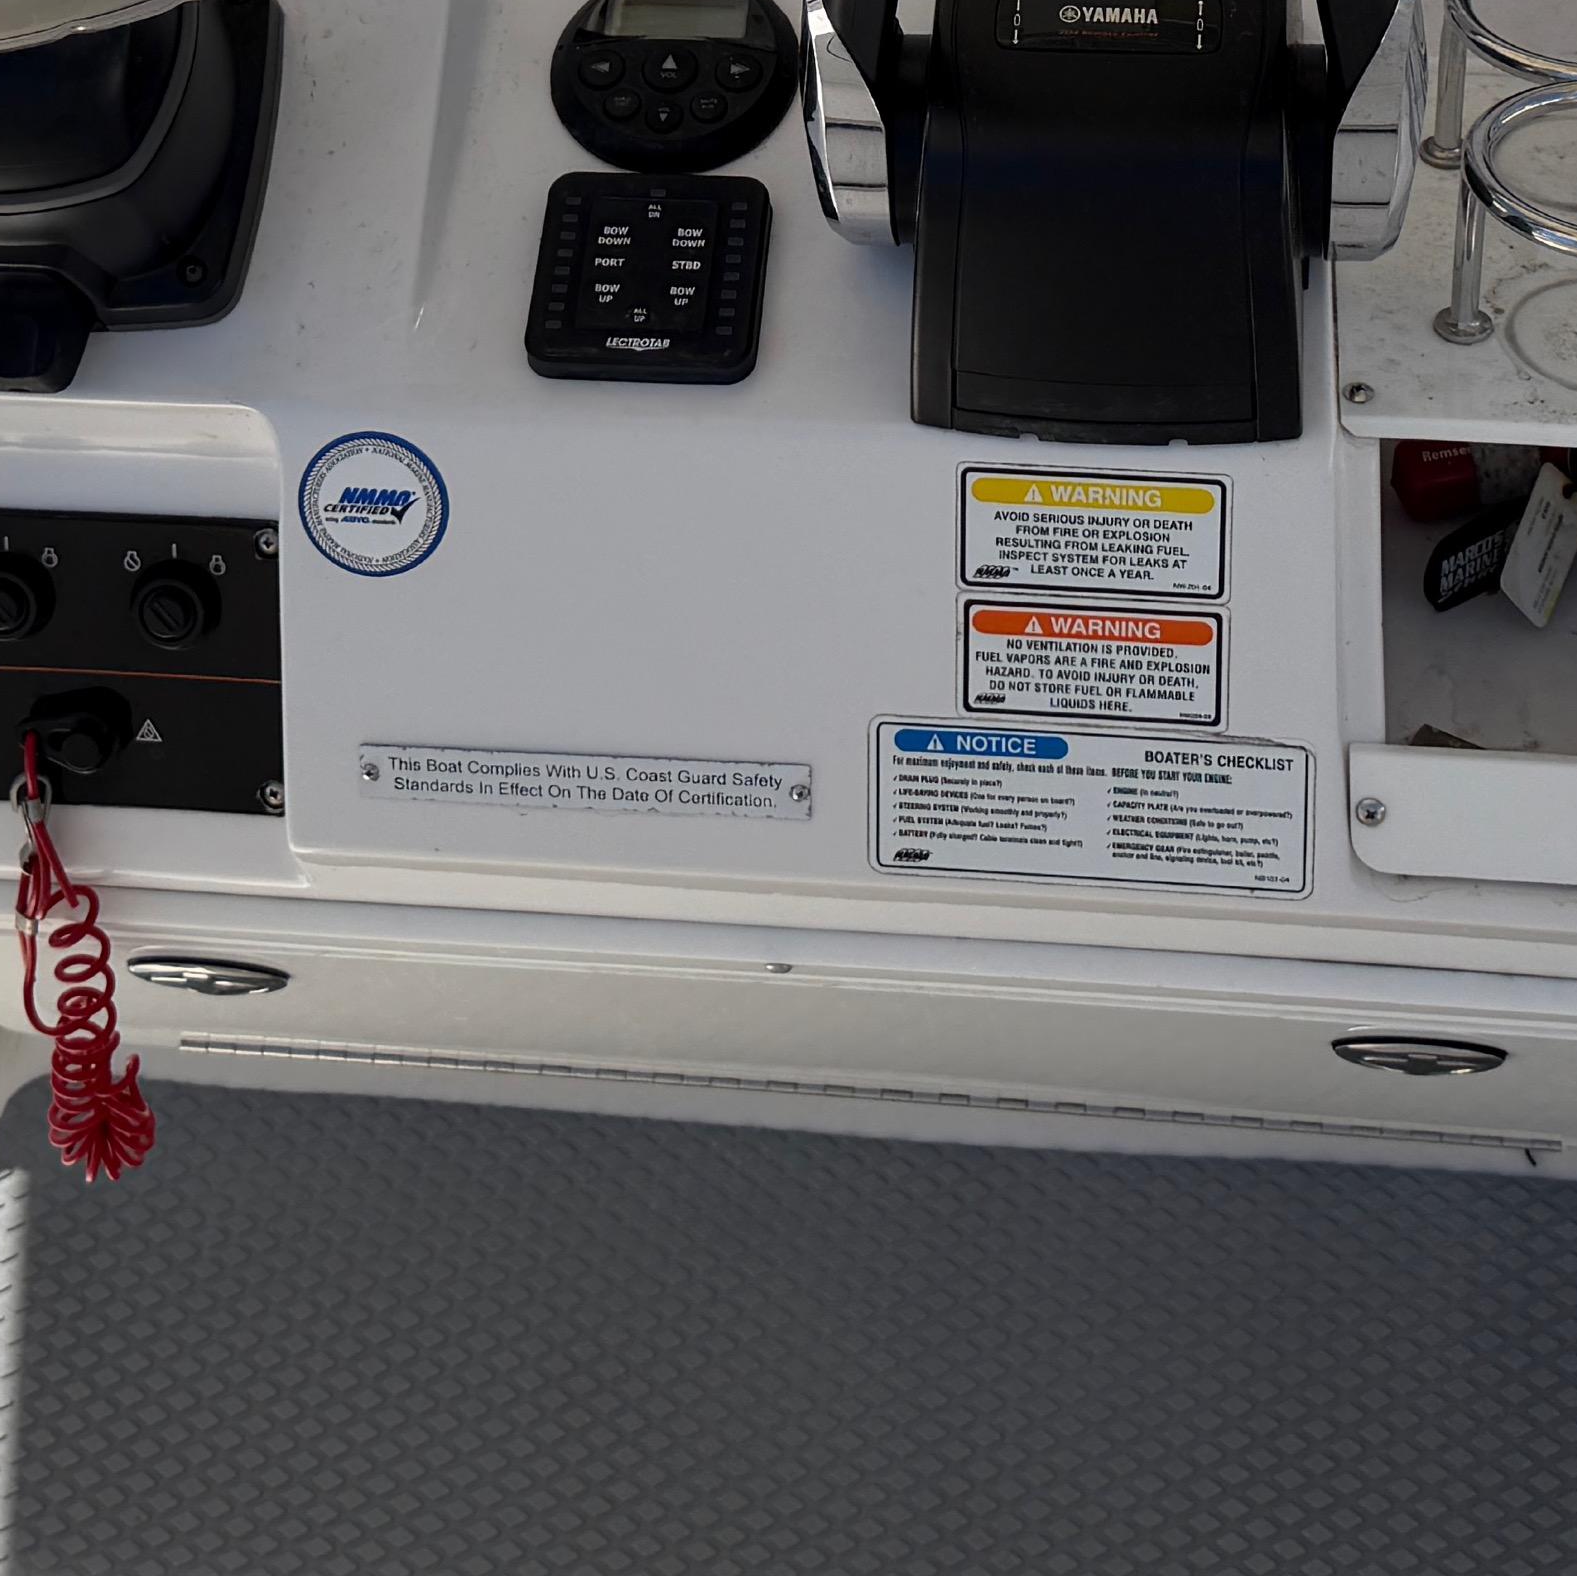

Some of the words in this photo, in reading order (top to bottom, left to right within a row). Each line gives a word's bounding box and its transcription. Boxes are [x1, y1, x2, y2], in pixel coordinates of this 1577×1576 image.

[1082, 6, 1158, 25] YAMAHA
[648, 204, 662, 212] ALL
[648, 211, 661, 219] DN
[603, 226, 629, 235] BOW
[677, 227, 703, 237] BOW
[598, 236, 631, 245] DOWN
[672, 238, 705, 247] DOWN
[594, 257, 625, 267] PORT
[671, 260, 701, 270] STBD
[595, 283, 620, 293] BOW
[670, 286, 695, 296] BOW
[598, 294, 613, 303] UP
[674, 297, 689, 306] UP
[633, 315, 645, 323] UP
[605, 336, 670, 349] LECTROTAB
[1421, 446, 1474, 463] Remse
[1050, 484, 1161, 507] WARNING
[323, 503, 390, 515] CERTIFIED
[994, 511, 1030, 523] AVOID
[1033, 513, 1085, 525] SERIOUS
[1087, 516, 1130, 528] INJURY
[1133, 518, 1150, 529] OR
[1154, 520, 1193, 531] DEATH
[1016, 525, 1050, 536] FROM
[1053, 527, 1079, 538] FIRE
[1082, 529, 1100, 539] OR
[1103, 530, 1170, 543] EXPLOSION
[995, 537, 1061, 550] RESULTING
[1064, 540, 1098, 552] FROM
[1101, 542, 1153, 555] LEAKING
[998, 550, 1048, 562] INSPECT
[1051, 553, 1099, 565] SYSTEM
[1102, 555, 1126, 566] FOR
[1129, 557, 1169, 569] LEAKS
[1172, 559, 1187, 570] AT
[1030, 564, 1068, 576] LEAST
[1071, 566, 1104, 578] ONCE
[1107, 568, 1116, 579] A
[1120, 569, 1154, 581] YEAR.
[1440, 547, 1502, 593] MARINE
[1050, 616, 1161, 640] WARNING
[1006, 638, 1022, 650] NO
[1026, 640, 1098, 655] VENTILATION
[1101, 643, 1113, 654] IS
[1116, 645, 1178, 659] PROVIDED.
[975, 651, 1003, 663] FUEL
[1006, 653, 1051, 666] VAPORS
[1054, 656, 1077, 667] ARE
[1080, 658, 1088, 668] A
[1091, 658, 1115, 670] FIRE
[1119, 659, 1143, 671] AND
[1146, 661, 1211, 675] EXPLOSION
[1039, 669, 1054, 680] TO
[1057, 670, 1091, 682] AVOID
[1094, 672, 1135, 684] INJURY
[1137, 674, 1155, 685] OR
[989, 680, 1006, 691] DO
[1008, 681, 1032, 692] NOT
[1035, 683, 1071, 695] STORE
[1074, 685, 1103, 696] FUEL
[1106, 687, 1123, 698] OR
[1126, 688, 1195, 702] FLAMMABLE
[1049, 697, 1096, 710] LIQUIDS
[1099, 700, 1133, 713] HERE.
[957, 735, 1037, 755] NOTICE
[1144, 750, 1213, 767] BOATER'S
[1217, 755, 1294, 771] CHECKLIST
[388, 756, 421, 772] This
[426, 758, 463, 774] Boat
[467, 760, 541, 778] Complies
[545, 764, 581, 778] With
[586, 765, 620, 781] U.S.
[626, 767, 672, 782] Coast
[678, 770, 726, 785] Guard
[732, 773, 782, 791] Safety
[1111, 767, 1139, 779] BEFORE
[1141, 769, 1157, 781] YOU
[1158, 771, 1181, 782] START
[1182, 772, 1203, 783] YOUR
[394, 777, 474, 793] Standards
[479, 781, 493, 795] In
[499, 782, 543, 798] Effect
[548, 785, 571, 799] On
[576, 785, 606, 800] The
[612, 787, 649, 802] Date
[654, 789, 674, 803] Of
[679, 790, 777, 808] Certification.
